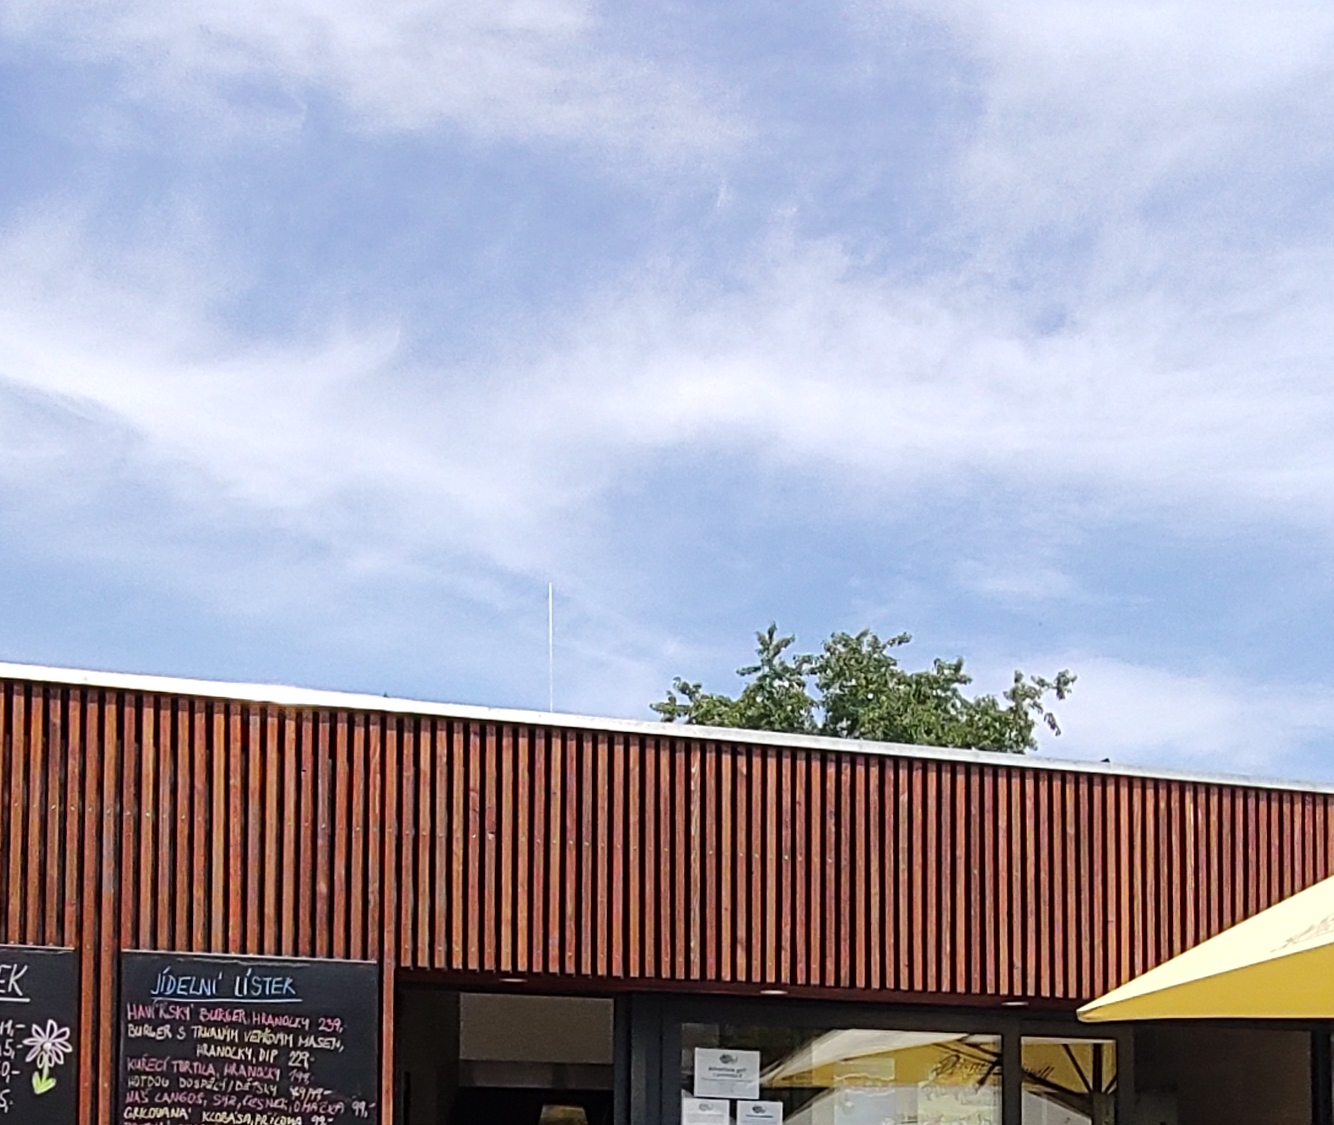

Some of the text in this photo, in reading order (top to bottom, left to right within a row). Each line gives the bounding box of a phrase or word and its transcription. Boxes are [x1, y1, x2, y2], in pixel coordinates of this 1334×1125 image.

[151, 966, 297, 997] JÍDELNÍ LÍSTEK
[127, 1023, 172, 1040] BURGER
[177, 1025, 187, 1040] S
[259, 1047, 279, 1064] DIP
